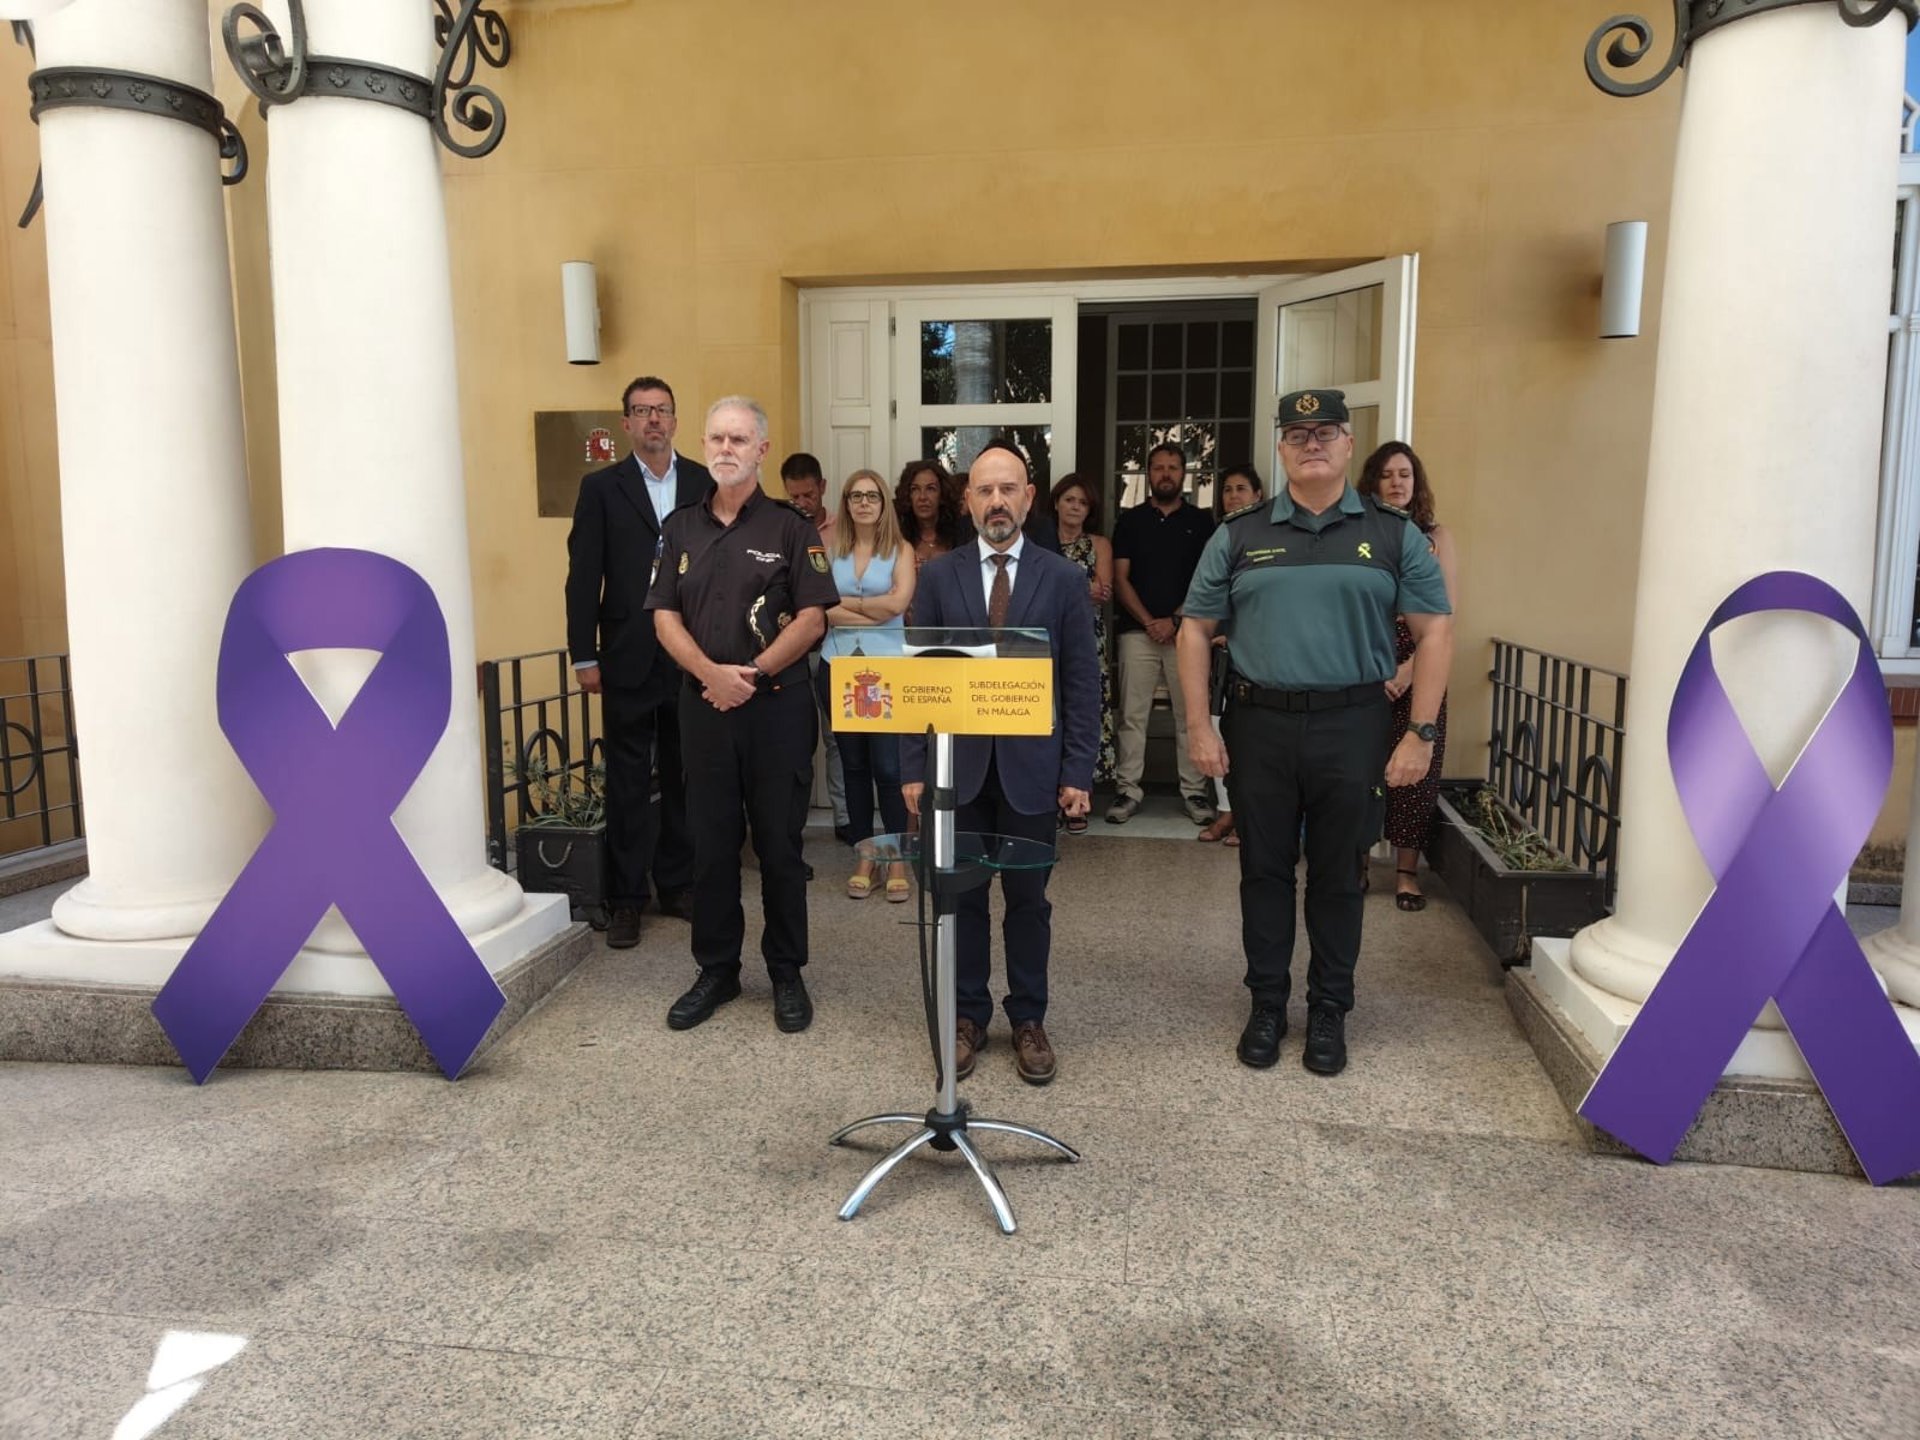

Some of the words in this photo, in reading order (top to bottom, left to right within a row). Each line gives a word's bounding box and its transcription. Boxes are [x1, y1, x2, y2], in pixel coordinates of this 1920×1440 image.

[902, 685, 953, 694] GOBIERNO
[969, 679, 1045, 690] SUBDELEGACIÓN
[902, 695, 915, 704] DE
[917, 694, 952, 704] ESPAÑA
[971, 694, 988, 703] DEL
[991, 694, 1040, 703] GOBIERNO
[977, 707, 990, 716] EN
[992, 705, 1031, 716] MÁLAGA
